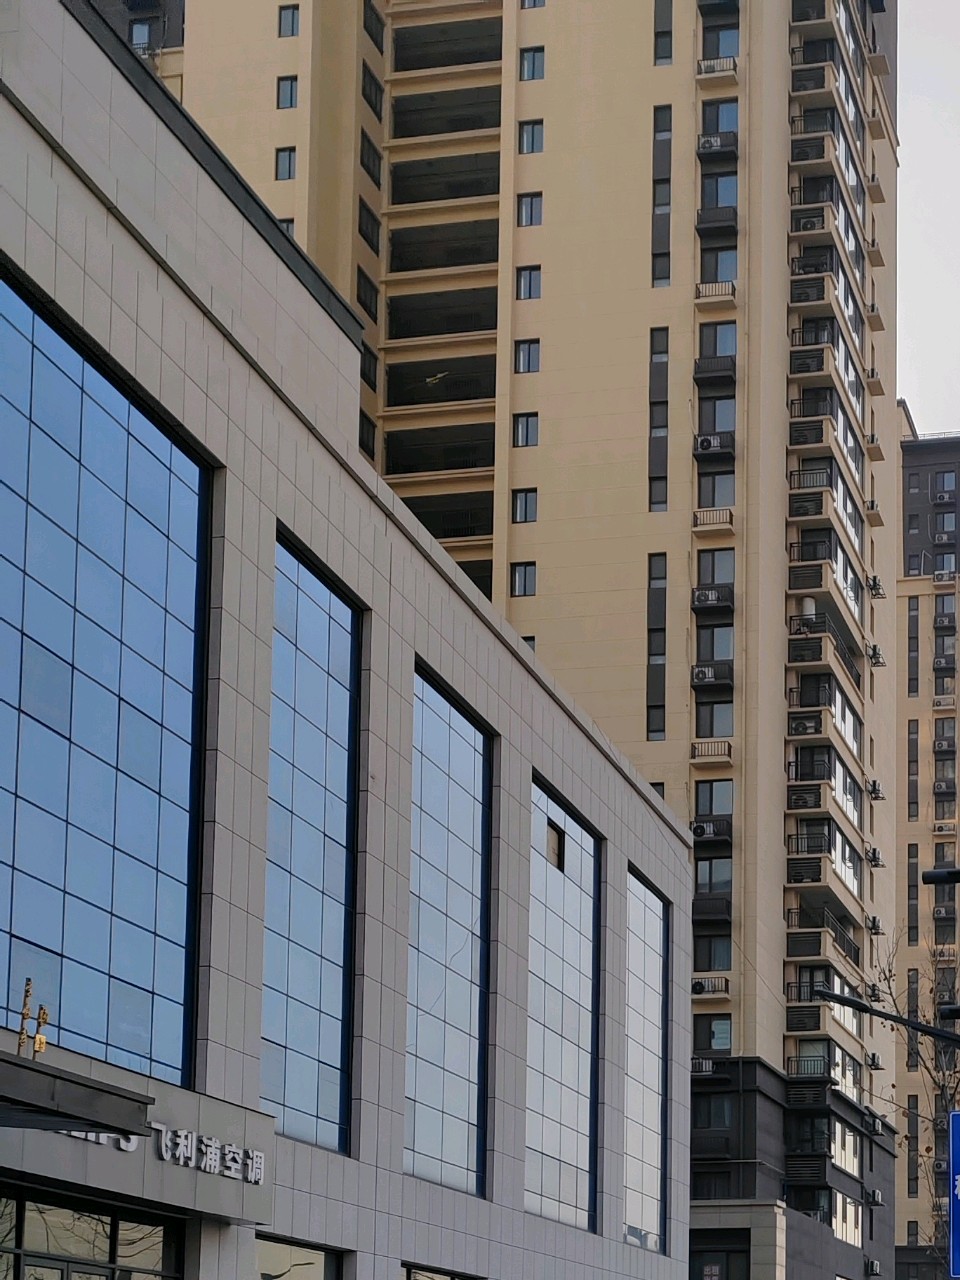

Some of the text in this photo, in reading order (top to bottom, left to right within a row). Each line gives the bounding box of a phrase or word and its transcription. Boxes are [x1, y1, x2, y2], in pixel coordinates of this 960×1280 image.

[146, 1121, 265, 1185] 飞利浦空调
